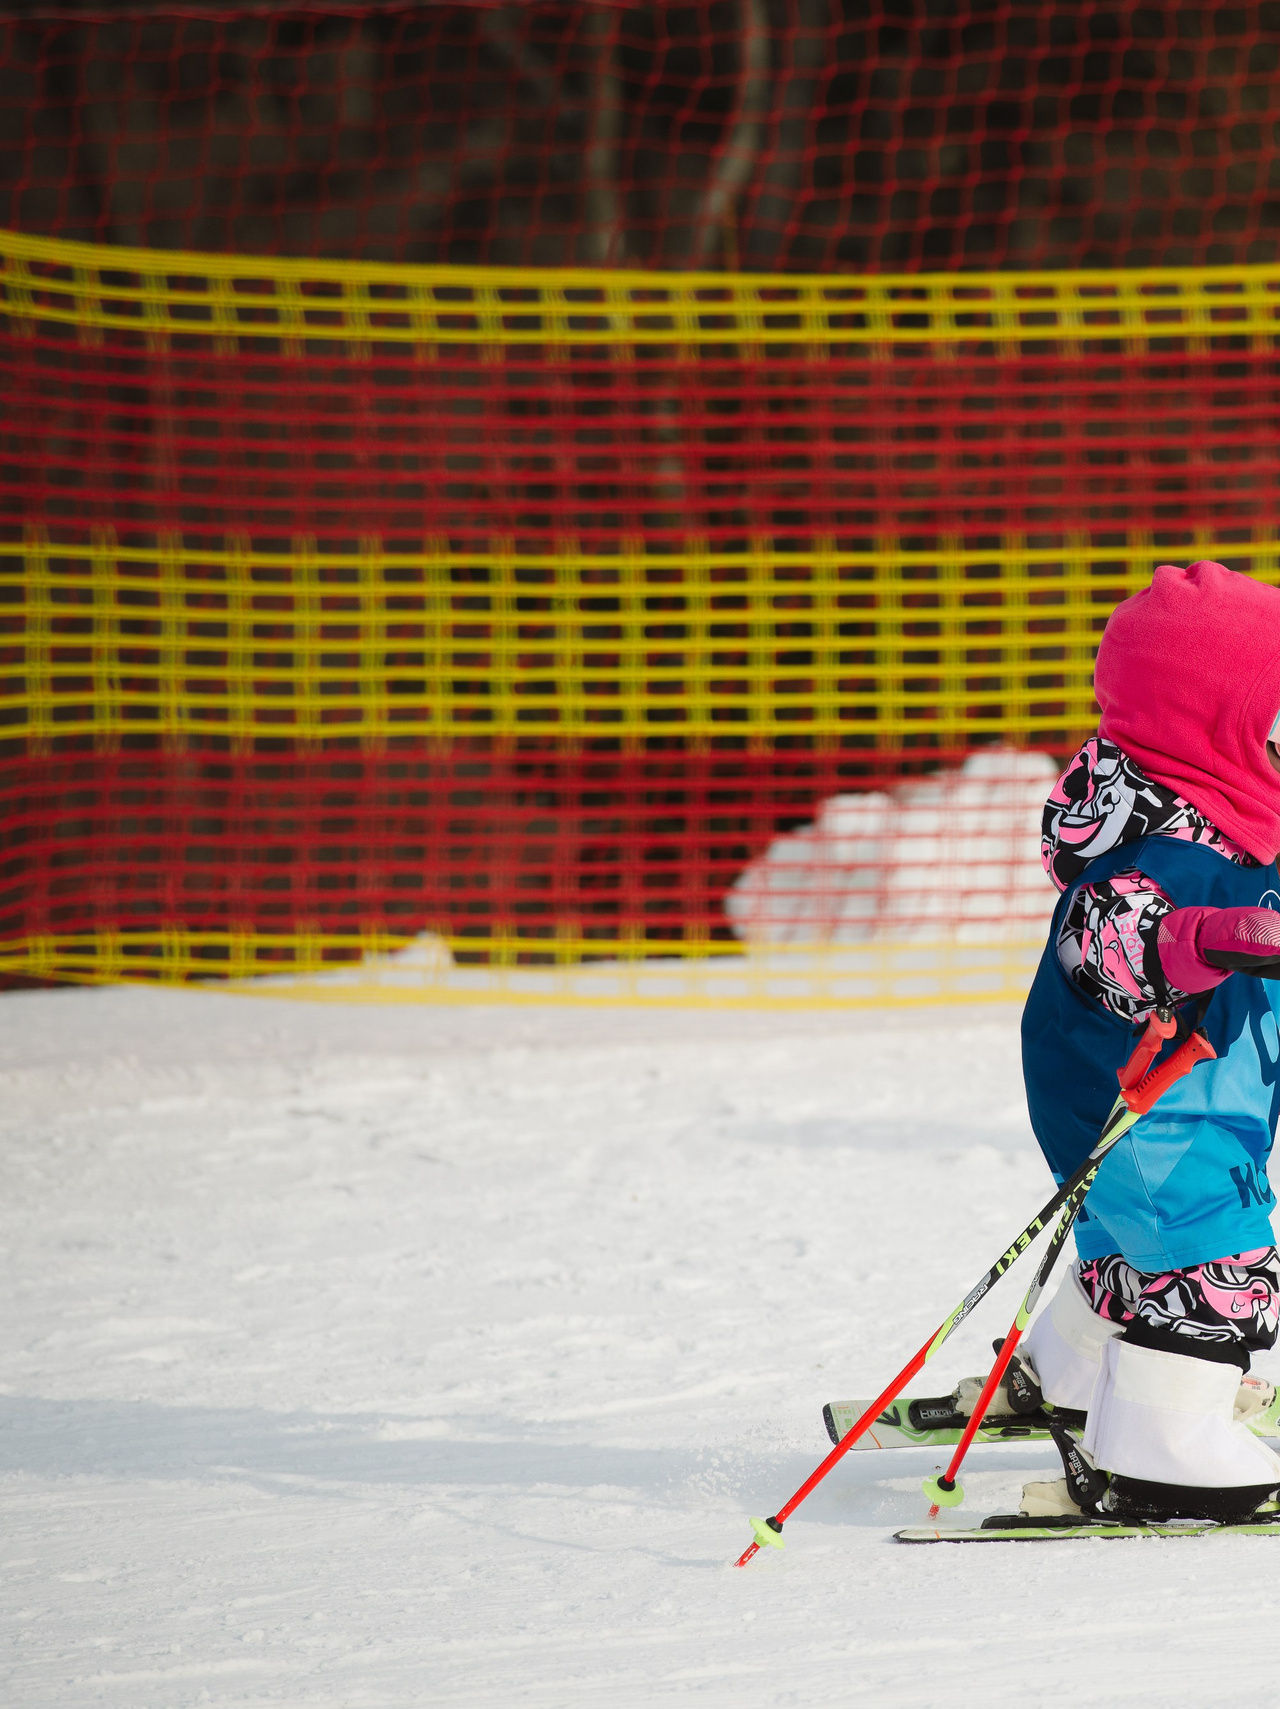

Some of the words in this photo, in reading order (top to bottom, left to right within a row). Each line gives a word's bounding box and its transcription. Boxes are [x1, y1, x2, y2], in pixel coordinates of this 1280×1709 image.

[995, 1217, 1044, 1276] LEKI
[953, 1282, 988, 1326] RACING
[1068, 1449, 1084, 1474] BABY
